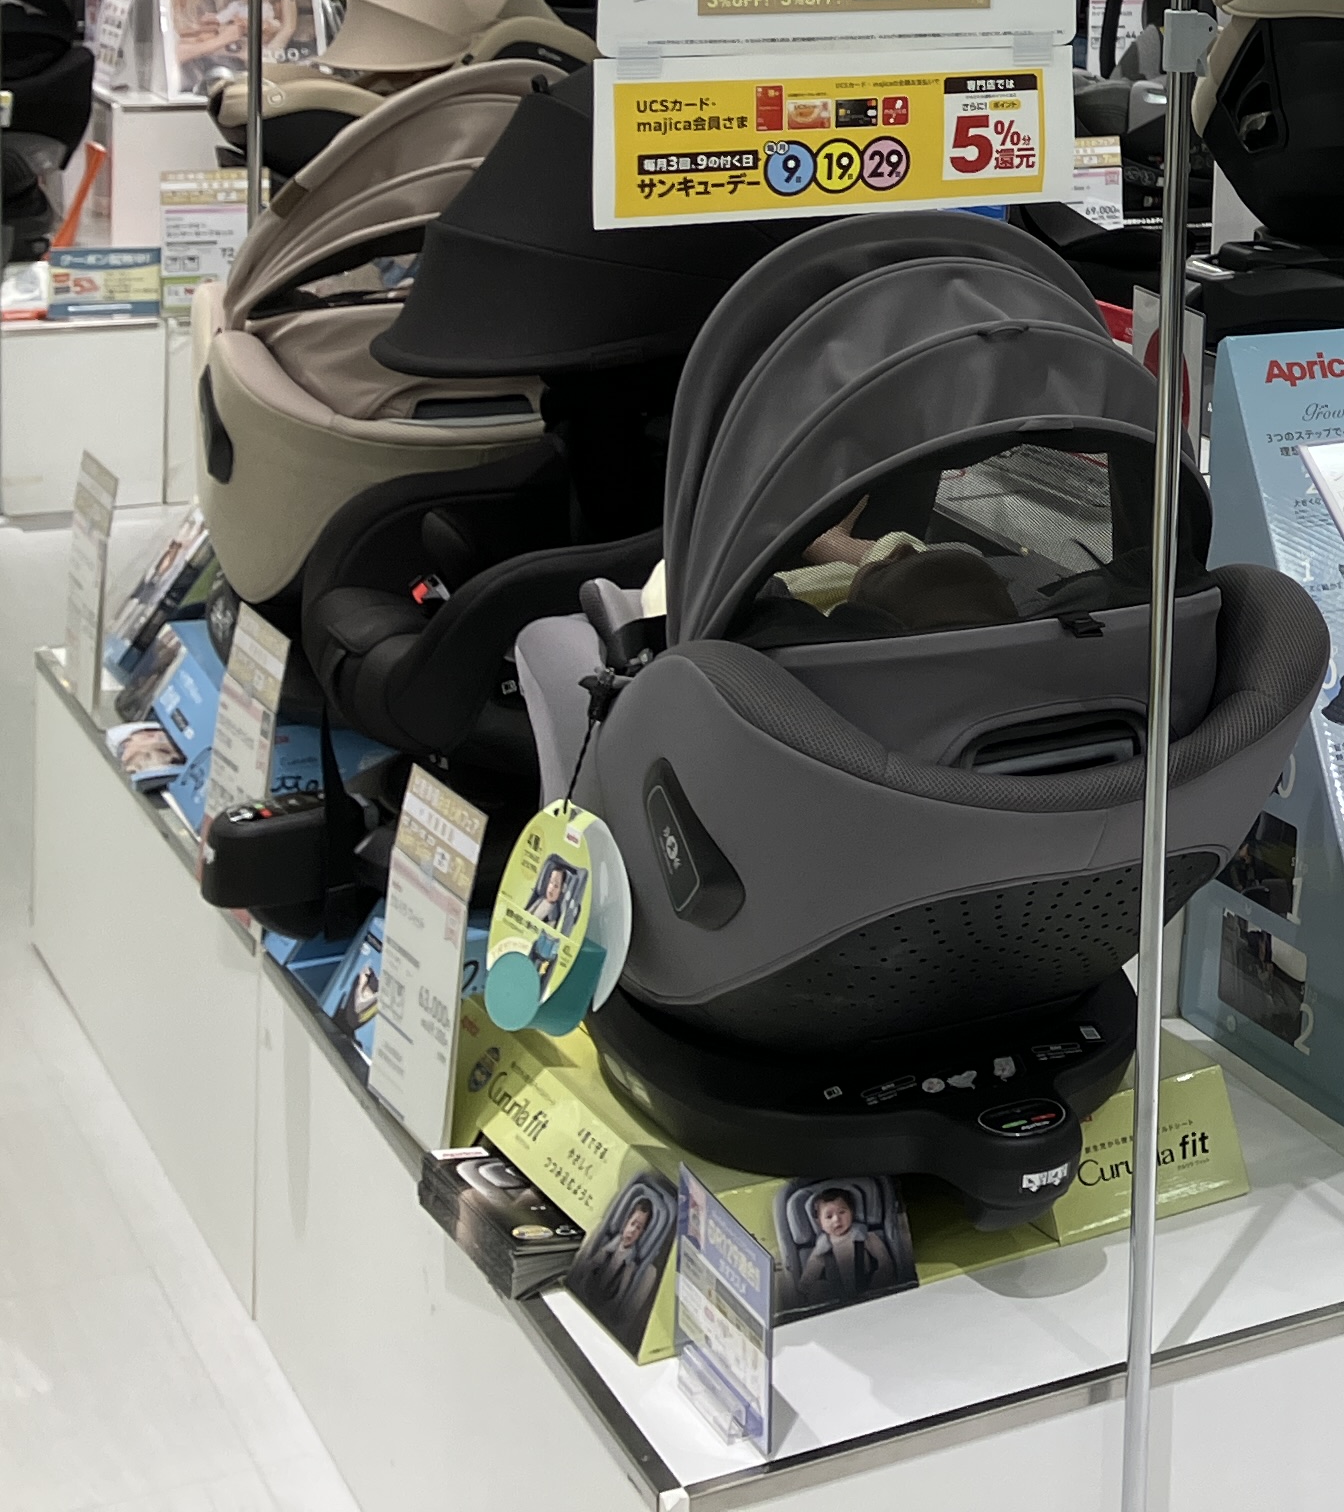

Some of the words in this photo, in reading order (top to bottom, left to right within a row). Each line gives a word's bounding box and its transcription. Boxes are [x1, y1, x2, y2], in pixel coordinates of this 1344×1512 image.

[636, 115, 749, 135] majica会員さま
[637, 174, 761, 199] サンキューデー
[1179, 1130, 1210, 1161] fit
